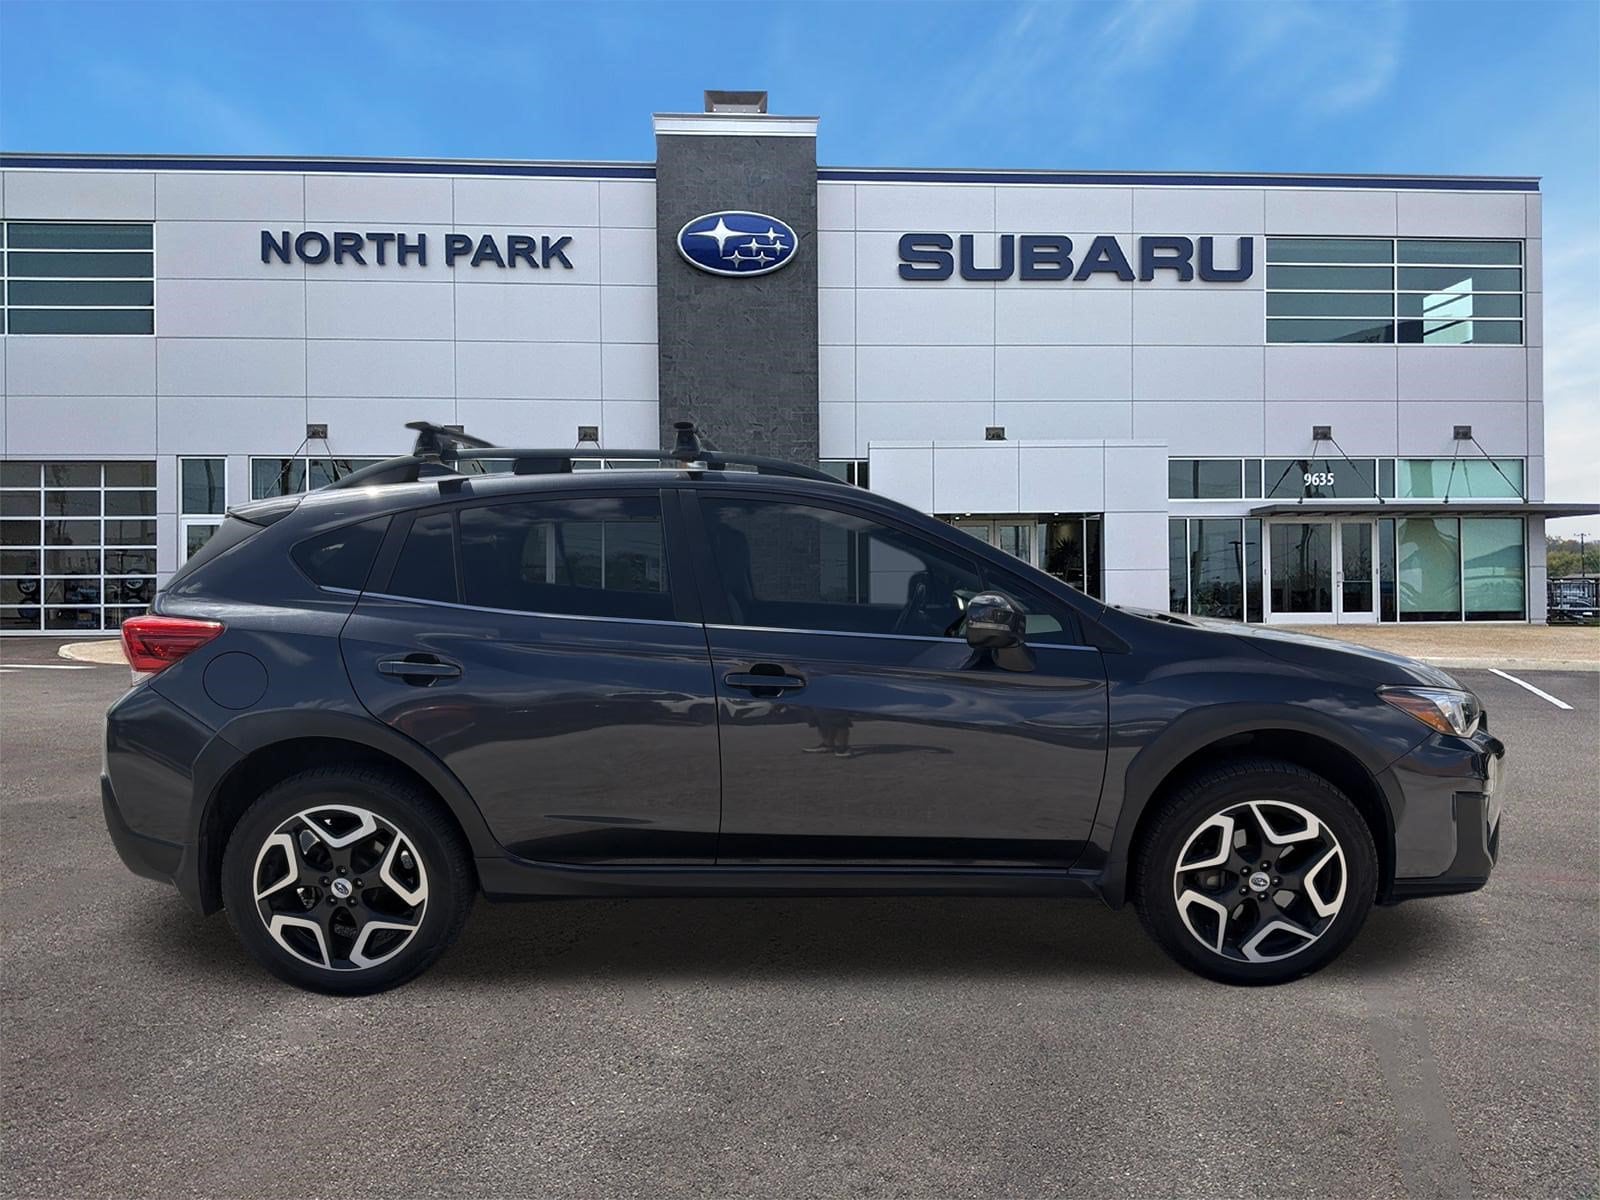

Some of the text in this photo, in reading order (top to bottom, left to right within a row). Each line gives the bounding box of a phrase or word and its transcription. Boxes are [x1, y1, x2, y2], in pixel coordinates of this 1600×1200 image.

[260, 230, 574, 269] NORTH PARK
[898, 233, 1254, 282] SUBARU
[1303, 472, 1335, 486] 9635
